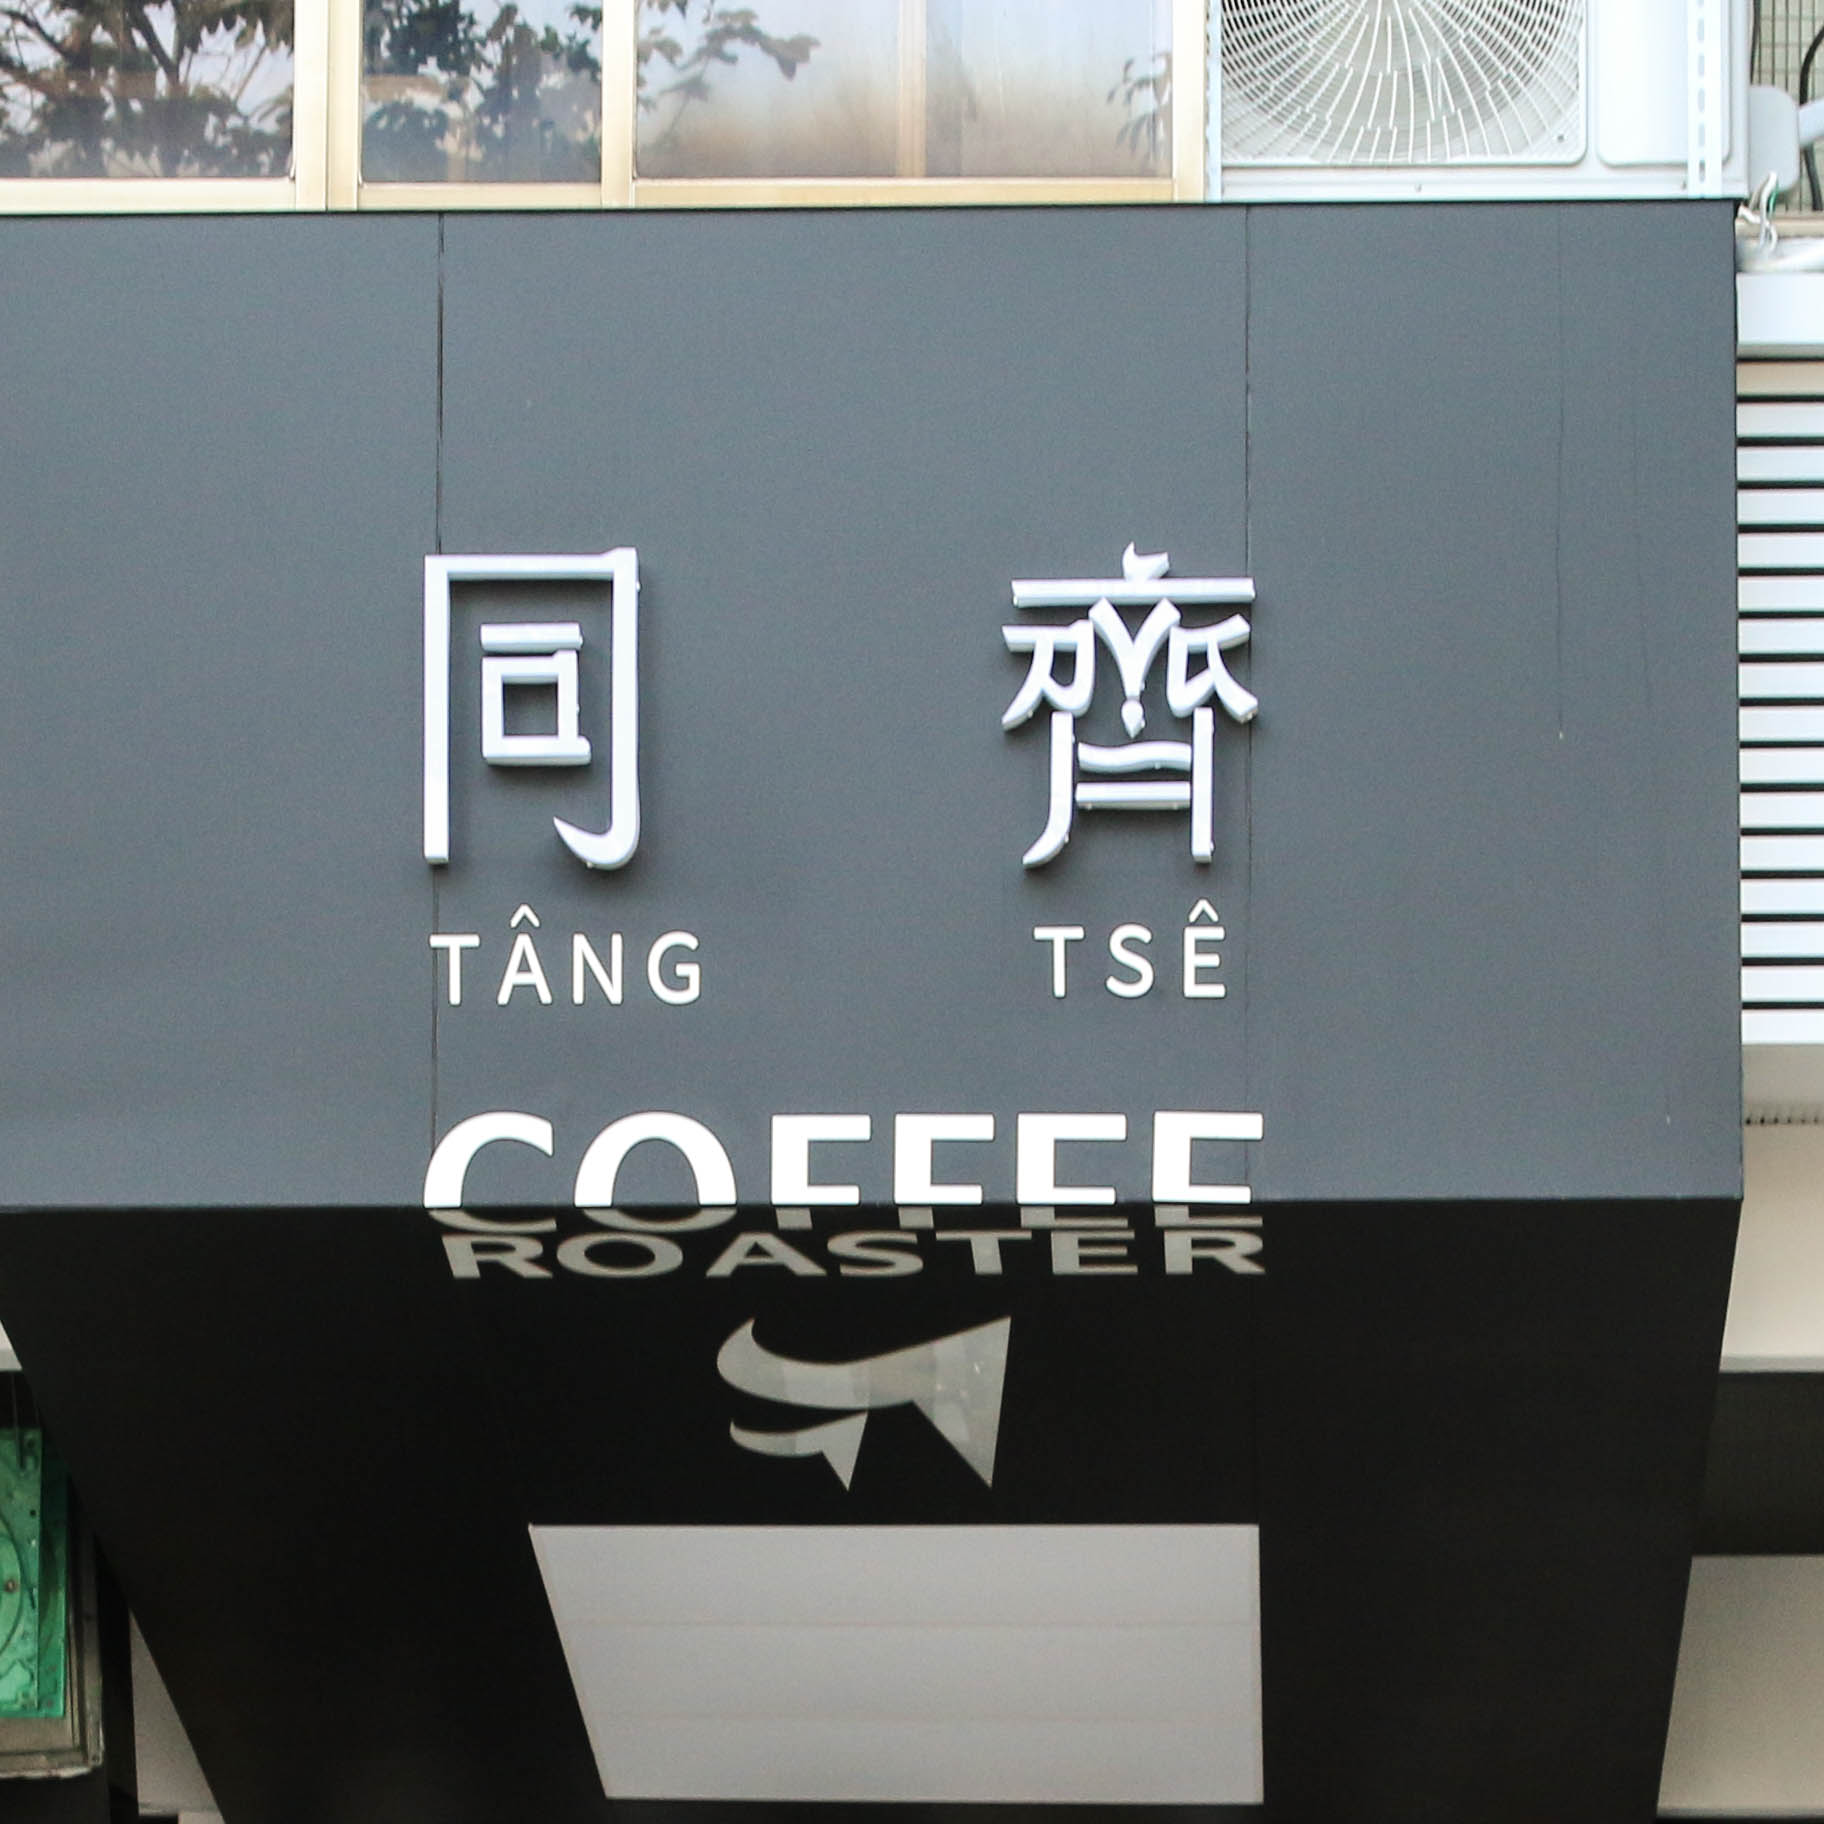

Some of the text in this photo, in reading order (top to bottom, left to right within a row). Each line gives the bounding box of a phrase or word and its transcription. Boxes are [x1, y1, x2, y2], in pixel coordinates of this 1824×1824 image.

[422, 541, 1259, 867] 同 齊
[429, 899, 1227, 1006] TÂNG TSÊ
[423, 1110, 1264, 1232] COFFEE
[441, 1229, 1265, 1278] ROASTER
